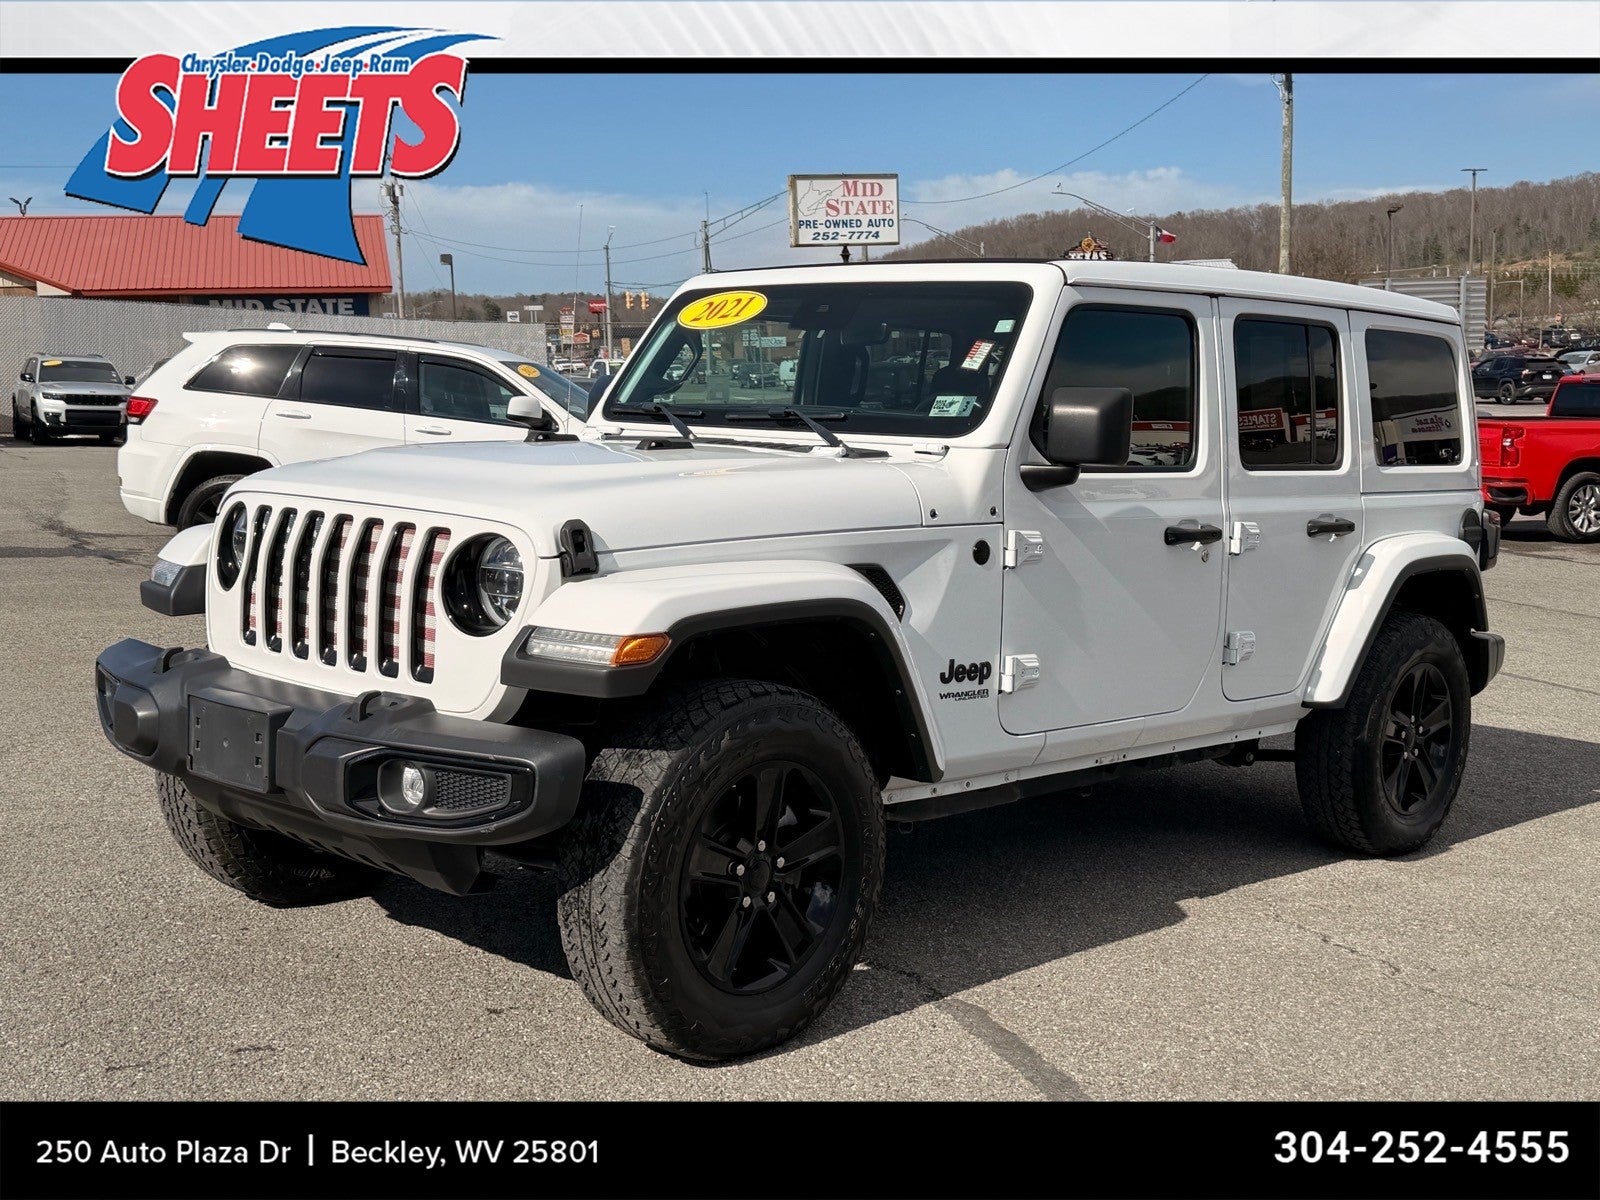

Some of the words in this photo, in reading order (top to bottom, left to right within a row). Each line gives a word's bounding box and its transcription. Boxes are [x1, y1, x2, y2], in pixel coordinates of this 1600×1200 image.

[841, 180, 884, 197] MID
[825, 199, 894, 217] STATE
[798, 219, 862, 229] PRE-OWNED
[867, 218, 895, 228] AUTO
[811, 231, 880, 241] 252-7774
[272, 298, 355, 315] STATE
[690, 296, 757, 323] 2021
[940, 659, 992, 685] Jeep
[939, 689, 990, 700] WRANGLER
